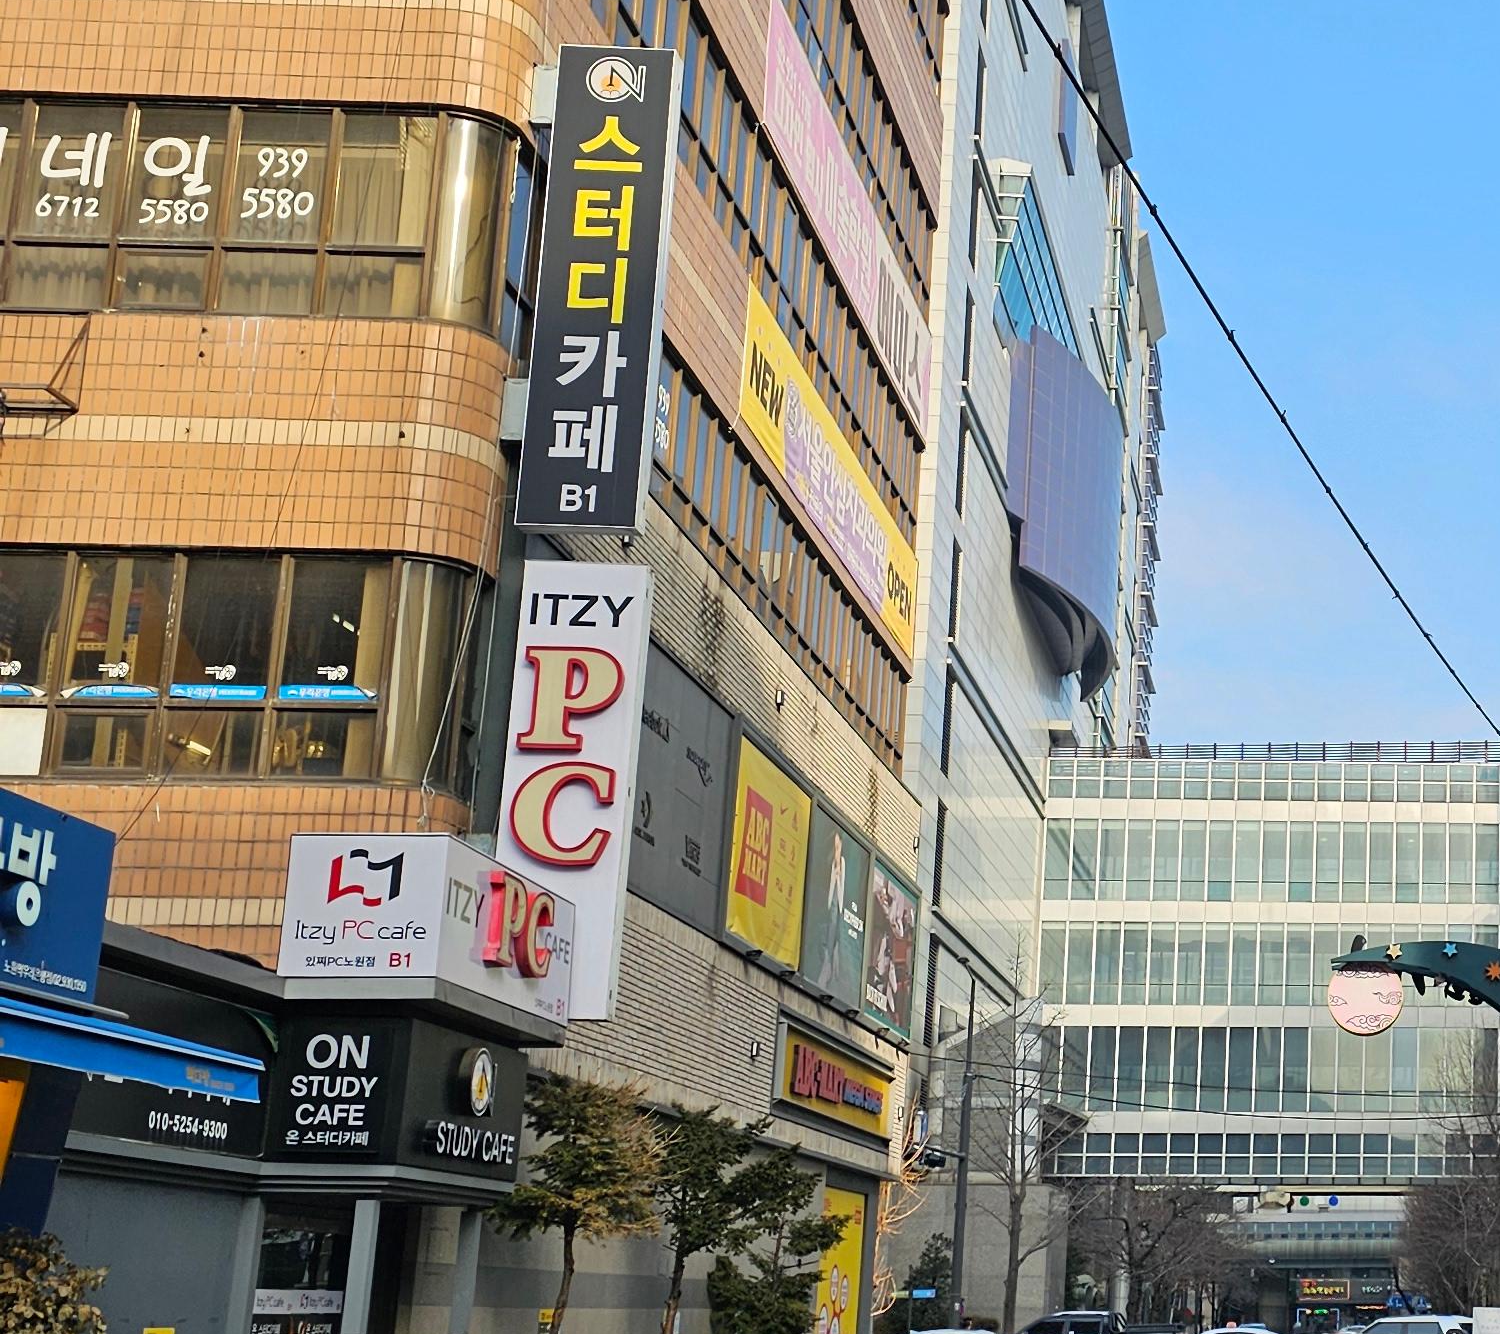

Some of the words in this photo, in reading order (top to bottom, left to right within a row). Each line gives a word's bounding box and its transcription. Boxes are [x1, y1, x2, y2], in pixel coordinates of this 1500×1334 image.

[256, 146, 309, 179] 939
[34, 195, 100, 220] 6712
[138, 197, 210, 226] 5580
[240, 186, 316, 219] 5580
[547, 114, 643, 475] 스터디카페
[558, 483, 598, 514] B1
[749, 341, 785, 428] NEW
[887, 560, 912, 626] OPEN
[528, 591, 634, 629] ITZY
[507, 644, 626, 866] PC
[745, 806, 770, 857] ABC
[445, 876, 485, 929] ITZY
[294, 919, 336, 945] Itzy
[342, 920, 375, 940] PC
[377, 920, 427, 940] cafe
[389, 952, 412, 968] B1
[305, 1033, 371, 1069] ON
[290, 1074, 379, 1099] STUDY
[148, 1110, 229, 1140] 010-5254-9300
[295, 1103, 365, 1127] CAFE
[285, 1129, 299, 1145] 온
[302, 1129, 370, 1146] 스터디카페
[436, 1120, 480, 1161] STUDY
[482, 1131, 515, 1166] CAFE
